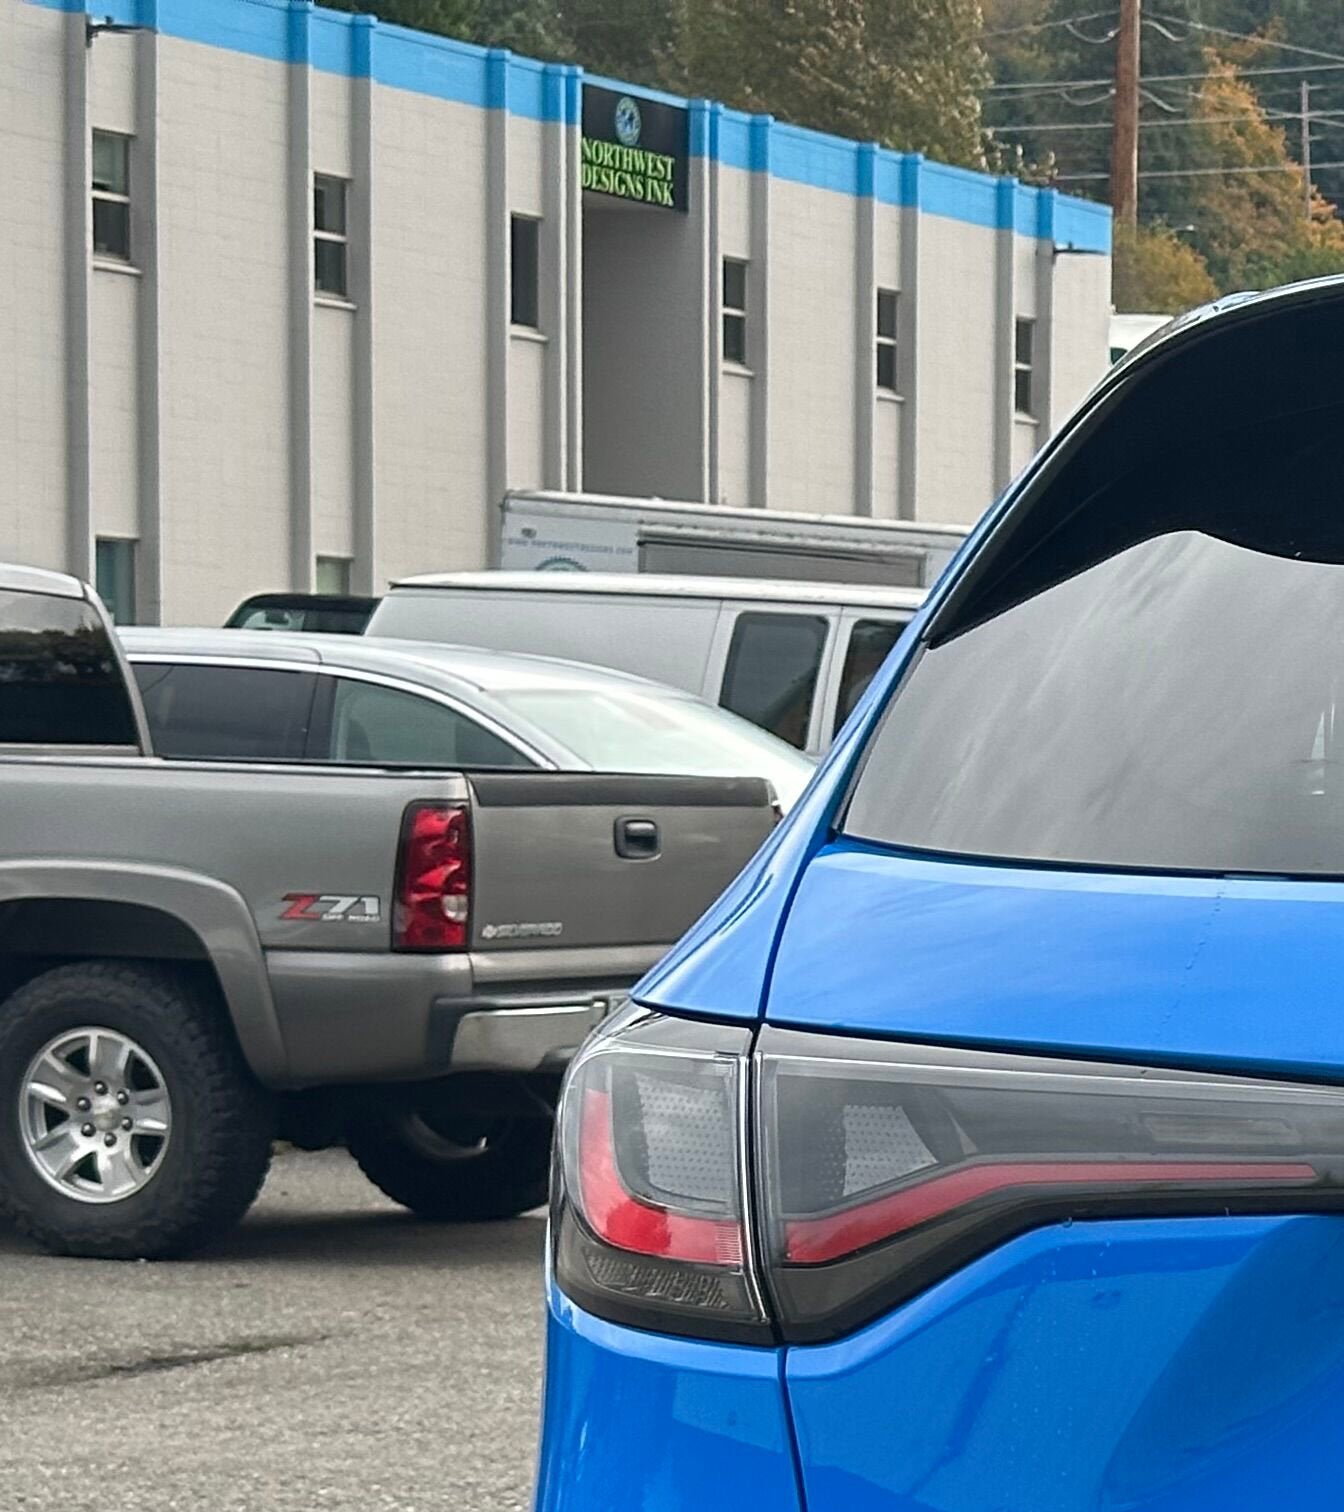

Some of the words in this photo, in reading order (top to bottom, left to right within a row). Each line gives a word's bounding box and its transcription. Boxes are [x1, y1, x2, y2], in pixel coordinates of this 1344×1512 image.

[581, 137, 676, 180] NORTHWEST
[581, 163, 645, 200] DESIGNS
[646, 178, 675, 206] INK
[279, 893, 381, 920] Z71
